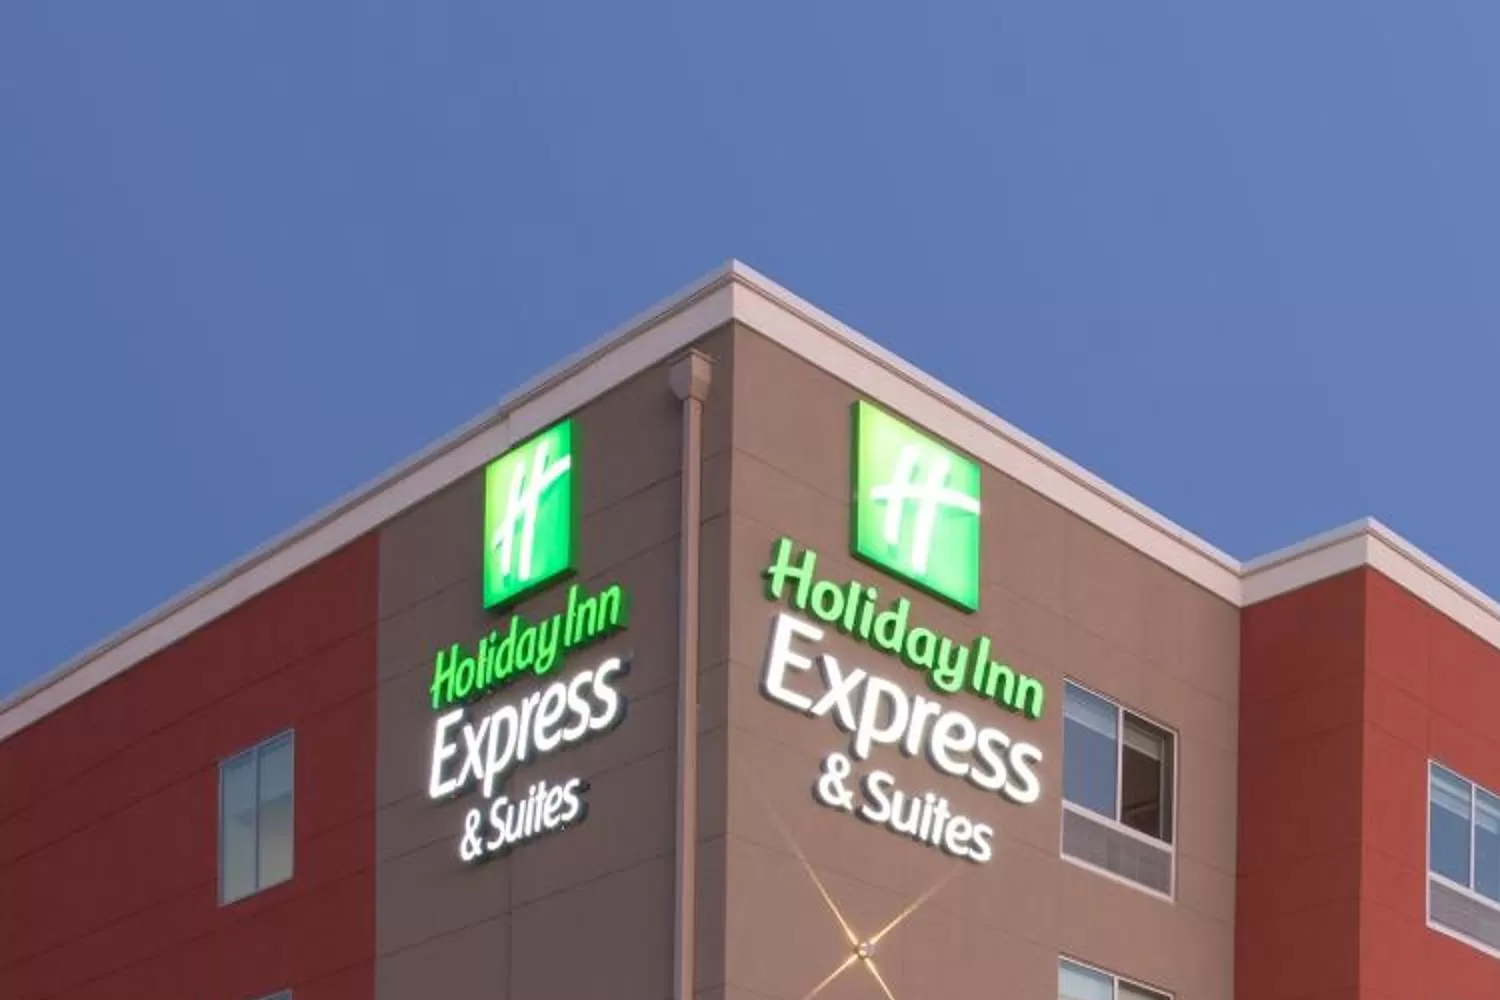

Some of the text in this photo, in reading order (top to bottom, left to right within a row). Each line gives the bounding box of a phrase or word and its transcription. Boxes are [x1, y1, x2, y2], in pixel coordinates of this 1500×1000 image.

[429, 583, 622, 710] Holiday Inn
[768, 536, 1045, 718] Holiday Inn
[428, 656, 622, 799] Express
[764, 611, 1043, 804] Express
[459, 777, 581, 863] & Suites
[818, 752, 994, 863] & Suites
